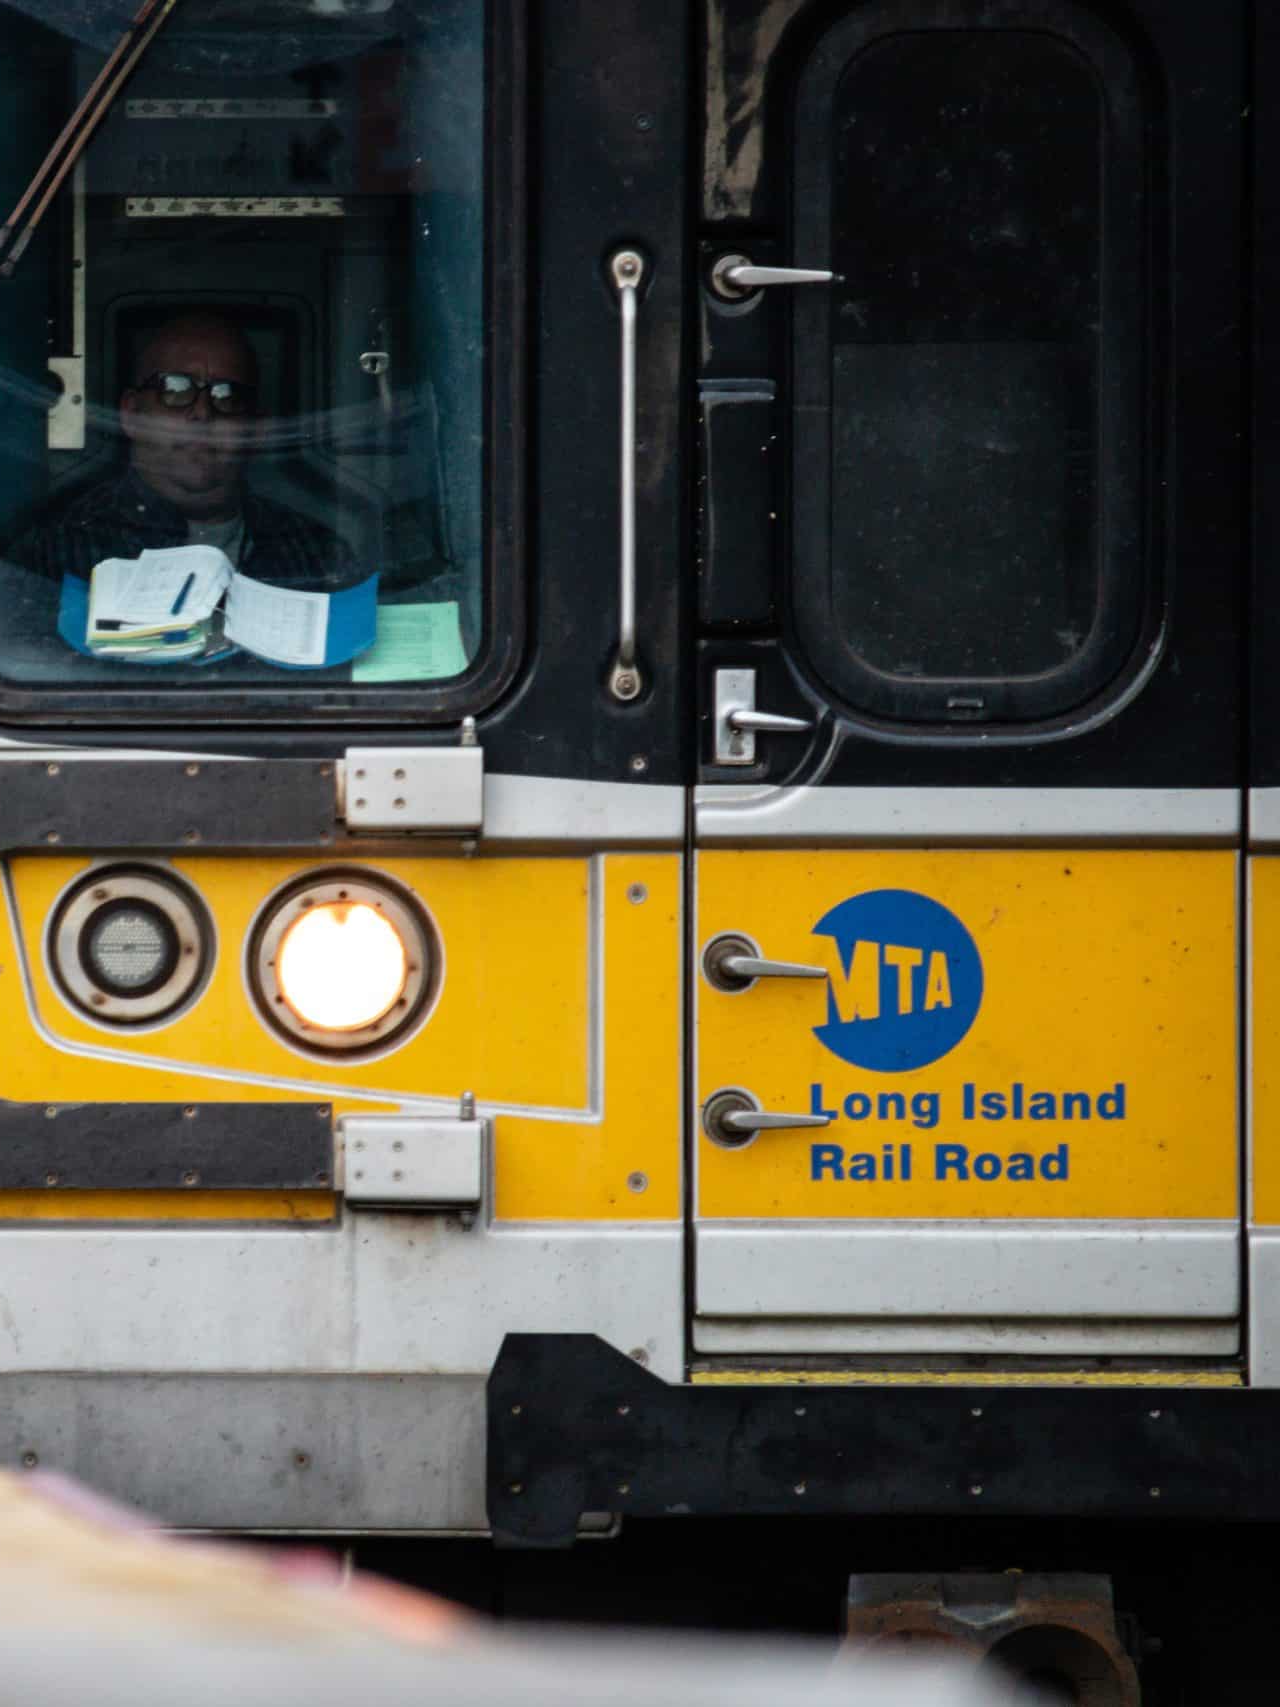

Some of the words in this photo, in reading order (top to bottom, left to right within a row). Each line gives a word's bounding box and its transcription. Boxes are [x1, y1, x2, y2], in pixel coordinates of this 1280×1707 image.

[813, 934, 952, 1025] MTA
[810, 1083, 940, 1128] Long
[963, 1083, 1126, 1120] Island
[810, 1144, 911, 1181] Rail
[934, 1144, 1069, 1181] Road
